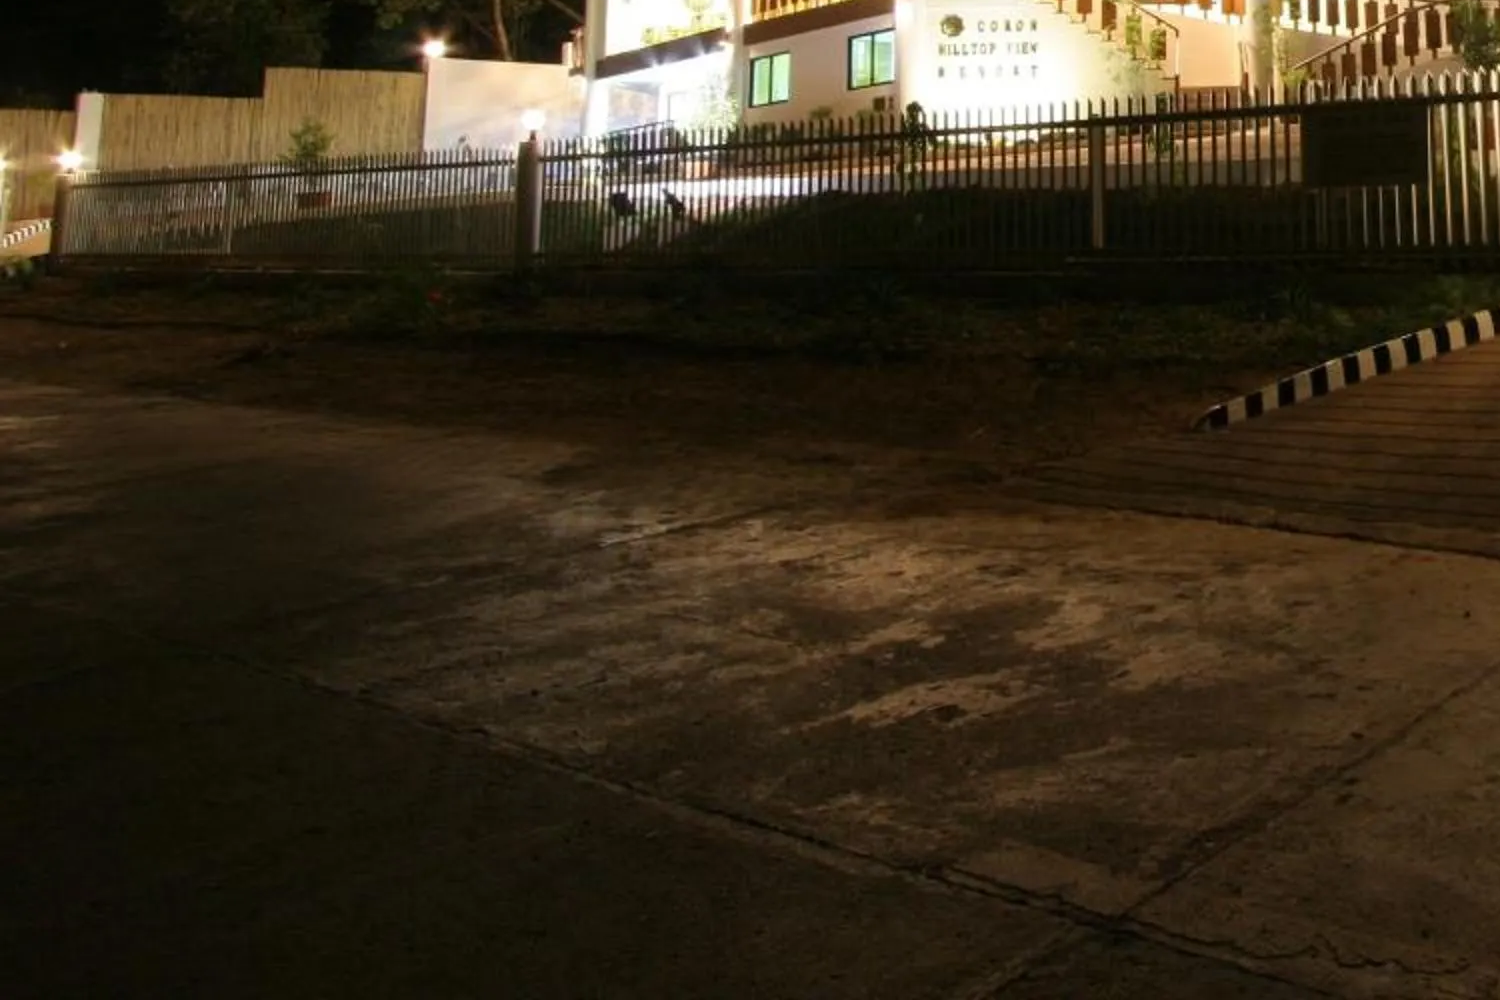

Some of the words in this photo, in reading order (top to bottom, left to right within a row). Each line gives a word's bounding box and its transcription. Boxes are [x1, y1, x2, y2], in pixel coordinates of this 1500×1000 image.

[978, 19, 1038, 32] CORON
[938, 42, 996, 56] HILLTOP
[1007, 41, 1038, 55] VIEW
[938, 65, 1038, 80] RESORT
